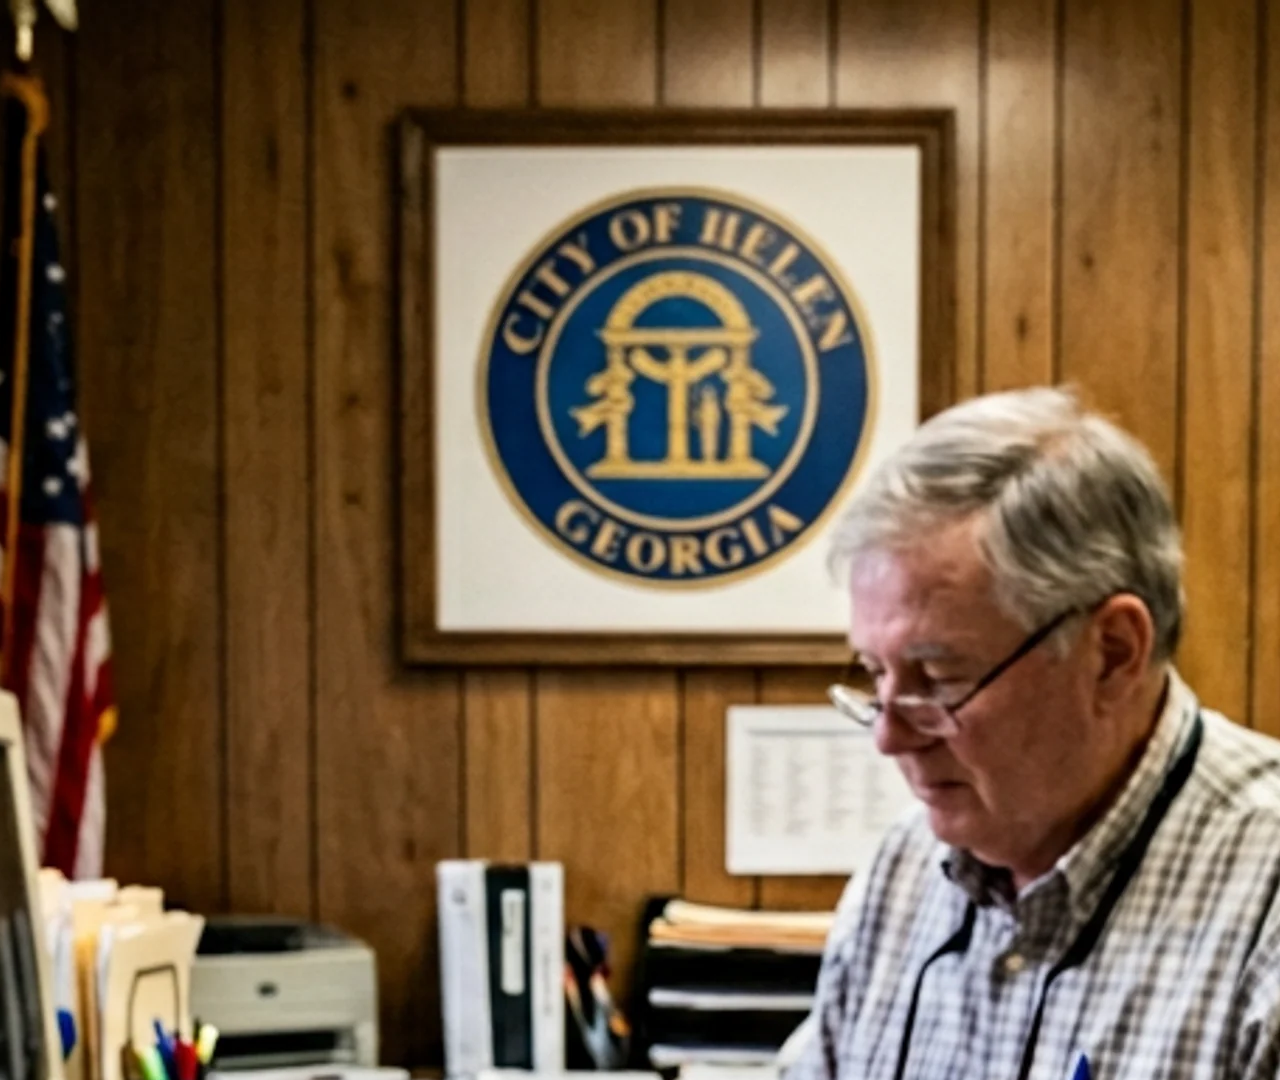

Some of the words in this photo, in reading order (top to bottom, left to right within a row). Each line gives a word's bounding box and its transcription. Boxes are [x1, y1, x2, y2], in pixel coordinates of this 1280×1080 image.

[502, 233, 597, 355] CITY
[609, 204, 681, 251] OF
[699, 206, 853, 352] HELEN
[554, 501, 803, 574] GEORGIA
